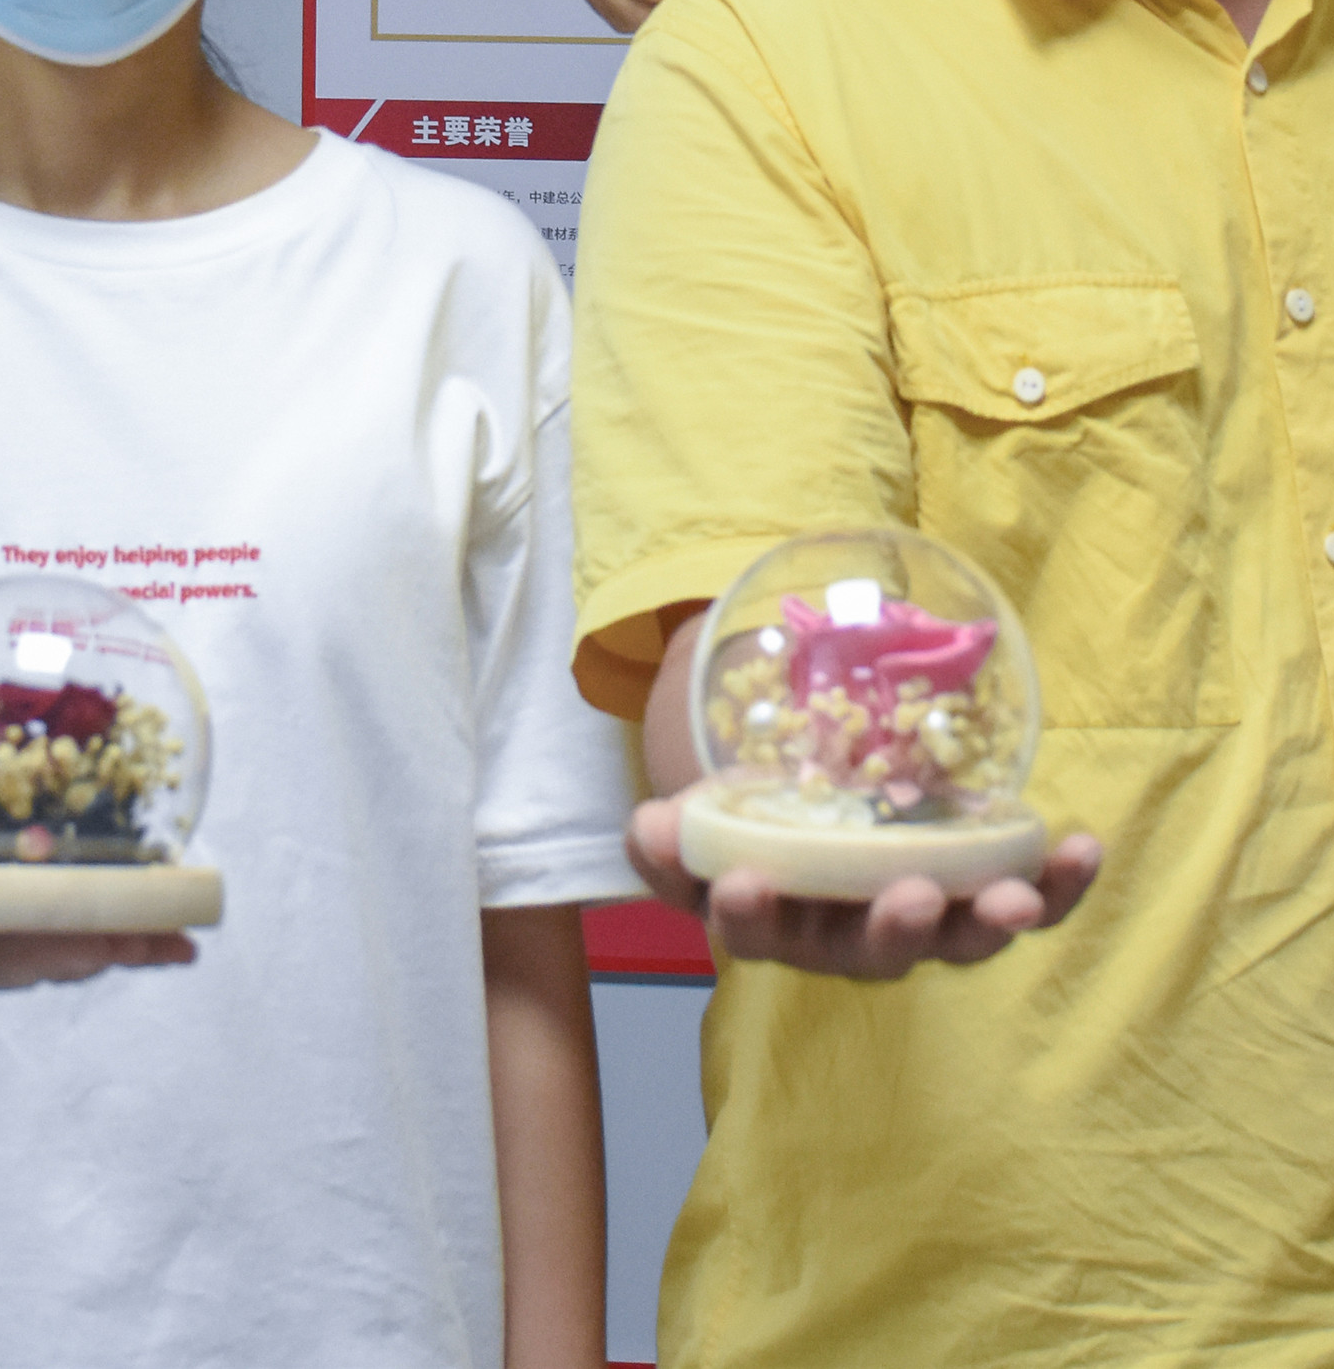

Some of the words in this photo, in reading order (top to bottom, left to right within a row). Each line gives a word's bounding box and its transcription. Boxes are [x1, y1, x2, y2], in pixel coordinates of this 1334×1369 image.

[411, 116, 534, 148] 主要荣誉
[497, 190, 583, 205] 年，中建总公
[3, 544, 50, 568] They
[55, 545, 108, 569] enjoy
[113, 543, 188, 568] helping
[194, 542, 260, 567] people
[180, 583, 257, 605] powers.
